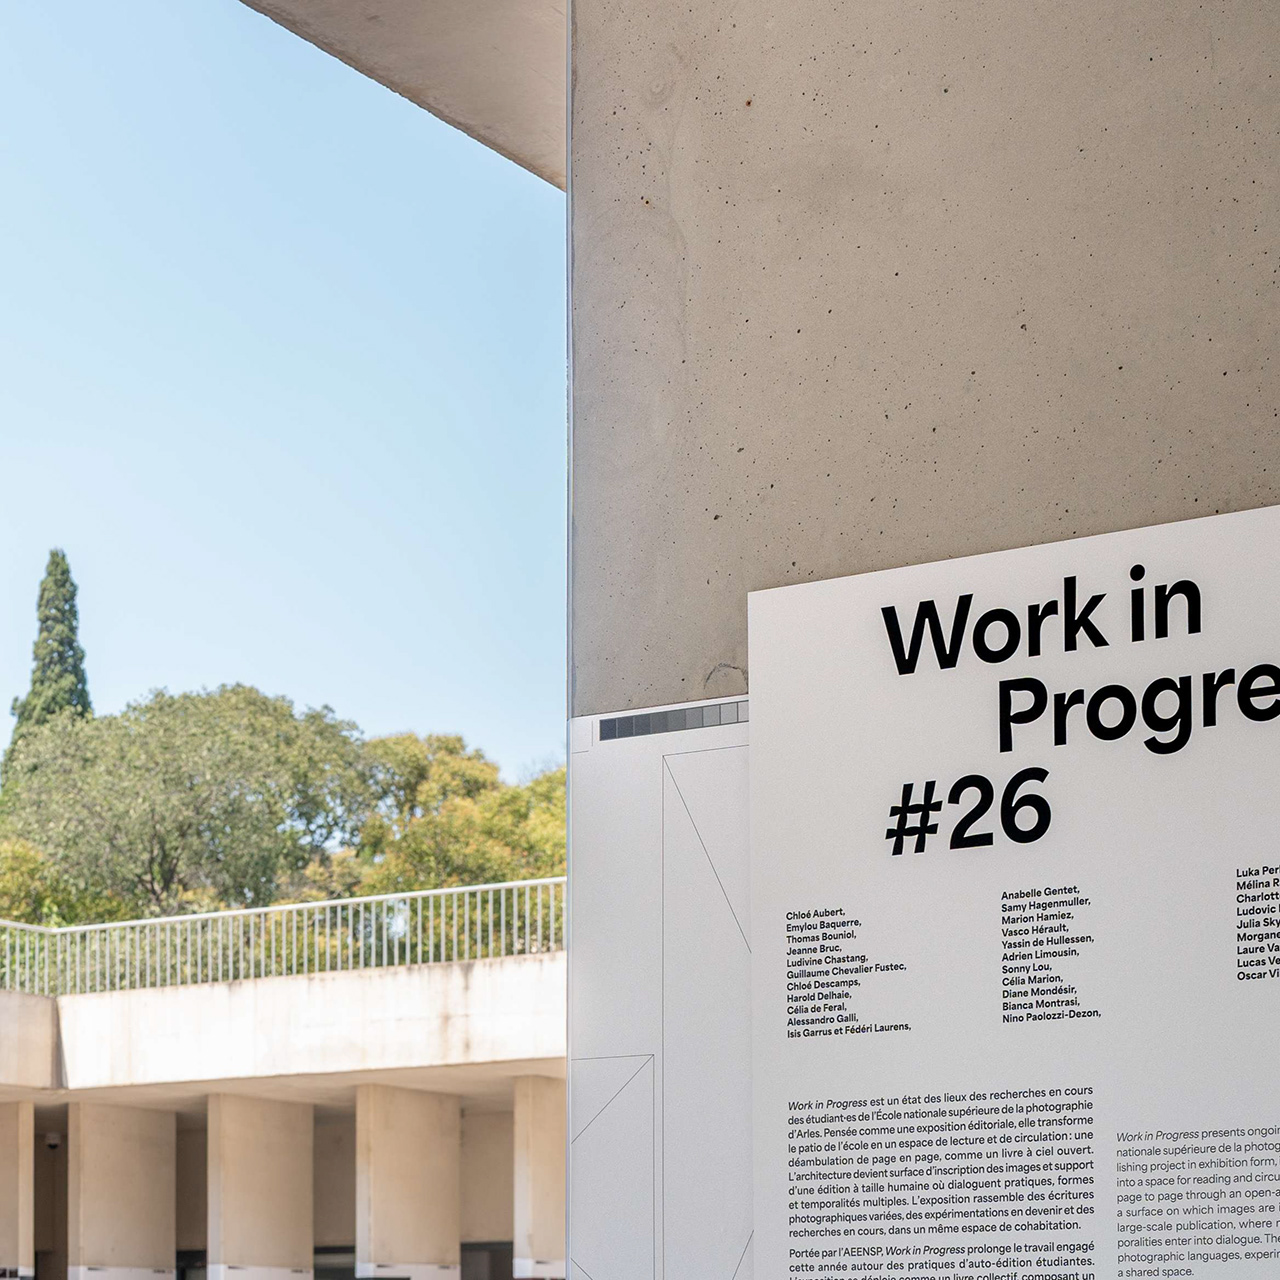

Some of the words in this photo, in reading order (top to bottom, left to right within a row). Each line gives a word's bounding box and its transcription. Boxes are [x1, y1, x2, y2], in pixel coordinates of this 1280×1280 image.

[881, 575, 1110, 676] Work
[1129, 563, 1202, 643] in
[884, 766, 1052, 856] #26
[1236, 867, 1260, 878] Luka
[1236, 879, 1271, 891] Mélina
[1000, 888, 1042, 901] Anabelle
[1043, 885, 1080, 897] Gentet,
[1001, 903, 1027, 913] Samy
[1028, 896, 1091, 912] Hagenmuller,
[1236, 904, 1277, 917] Ludovic
[785, 909, 812, 921] Chloé
[812, 907, 846, 919] Aubert,
[1001, 913, 1035, 925] Marion
[1036, 910, 1075, 922] Hamiez,
[786, 921, 818, 934] Emylou
[819, 919, 862, 931] Baquerre,
[1001, 927, 1030, 938] Vasco
[1031, 923, 1069, 935] Hérault,
[1236, 918, 1261, 930] Julia
[786, 934, 821, 944] Thomas
[821, 929, 857, 941] Bouniol,
[1001, 938, 1031, 950] Yassin
[1032, 937, 1045, 947] de
[1046, 935, 1095, 946] Hullessen,
[786, 946, 818, 956] Jeanne
[819, 944, 843, 953] Bruc,
[1001, 951, 1033, 962] Adrien
[1034, 946, 1080, 960] Limousin,
[1236, 945, 1266, 955] Laure
[786, 956, 823, 968] Ludivine
[824, 954, 869, 965] Chastang,
[1001, 964, 1031, 975] Sonny
[1032, 962, 1053, 972] Lou,
[1237, 958, 1267, 968] Lucas
[786, 969, 831, 980] Guillaume
[831, 964, 874, 976] Chevalier
[874, 962, 907, 973] Fustec,
[1236, 971, 1268, 981] Oscar
[786, 980, 812, 992] Chloé
[813, 979, 861, 990] Descamps,
[1001, 976, 1026, 987] Célia
[1027, 973, 1064, 985] Marion,
[786, 992, 816, 1003] Harold
[817, 989, 852, 1001] Delhaie,
[1002, 989, 1029, 999] Diane
[1030, 984, 1078, 997] Mondésir,
[786, 1004, 809, 1015] Célia
[810, 1004, 822, 1014] de
[823, 1001, 848, 1013] Feral,
[1002, 1001, 1034, 1011] Bianca
[1035, 996, 1081, 1009] Montrasi,
[786, 1015, 835, 1027] Alessandro
[836, 1012, 859, 1024] Galli,
[1002, 1013, 1025, 1024] Nino
[1026, 1009, 1102, 1022] Paolozzi-Dezon,
[787, 1029, 802, 1039] Isis
[802, 1028, 833, 1038] Garrus
[833, 1026, 844, 1036] et
[874, 1023, 912, 1033] Laurens,
[788, 1100, 814, 1111] Work
[814, 1099, 824, 1110] in
[826, 1099, 868, 1111] Progress
[869, 1097, 885, 1107] est
[887, 1097, 900, 1106] un
[901, 1094, 922, 1105] état
[923, 1093, 942, 1104] des
[943, 1092, 967, 1103] lieux
[968, 1091, 988, 1102] des
[989, 1087, 1047, 1100] recherches
[1048, 1088, 1062, 1097] en
[1064, 1086, 1094, 1096] cours
[1116, 1131, 1144, 1143] Work
[1144, 1131, 1154, 1141] in
[1155, 1130, 1200, 1143] Progress
[1201, 1127, 1246, 1141] presents
